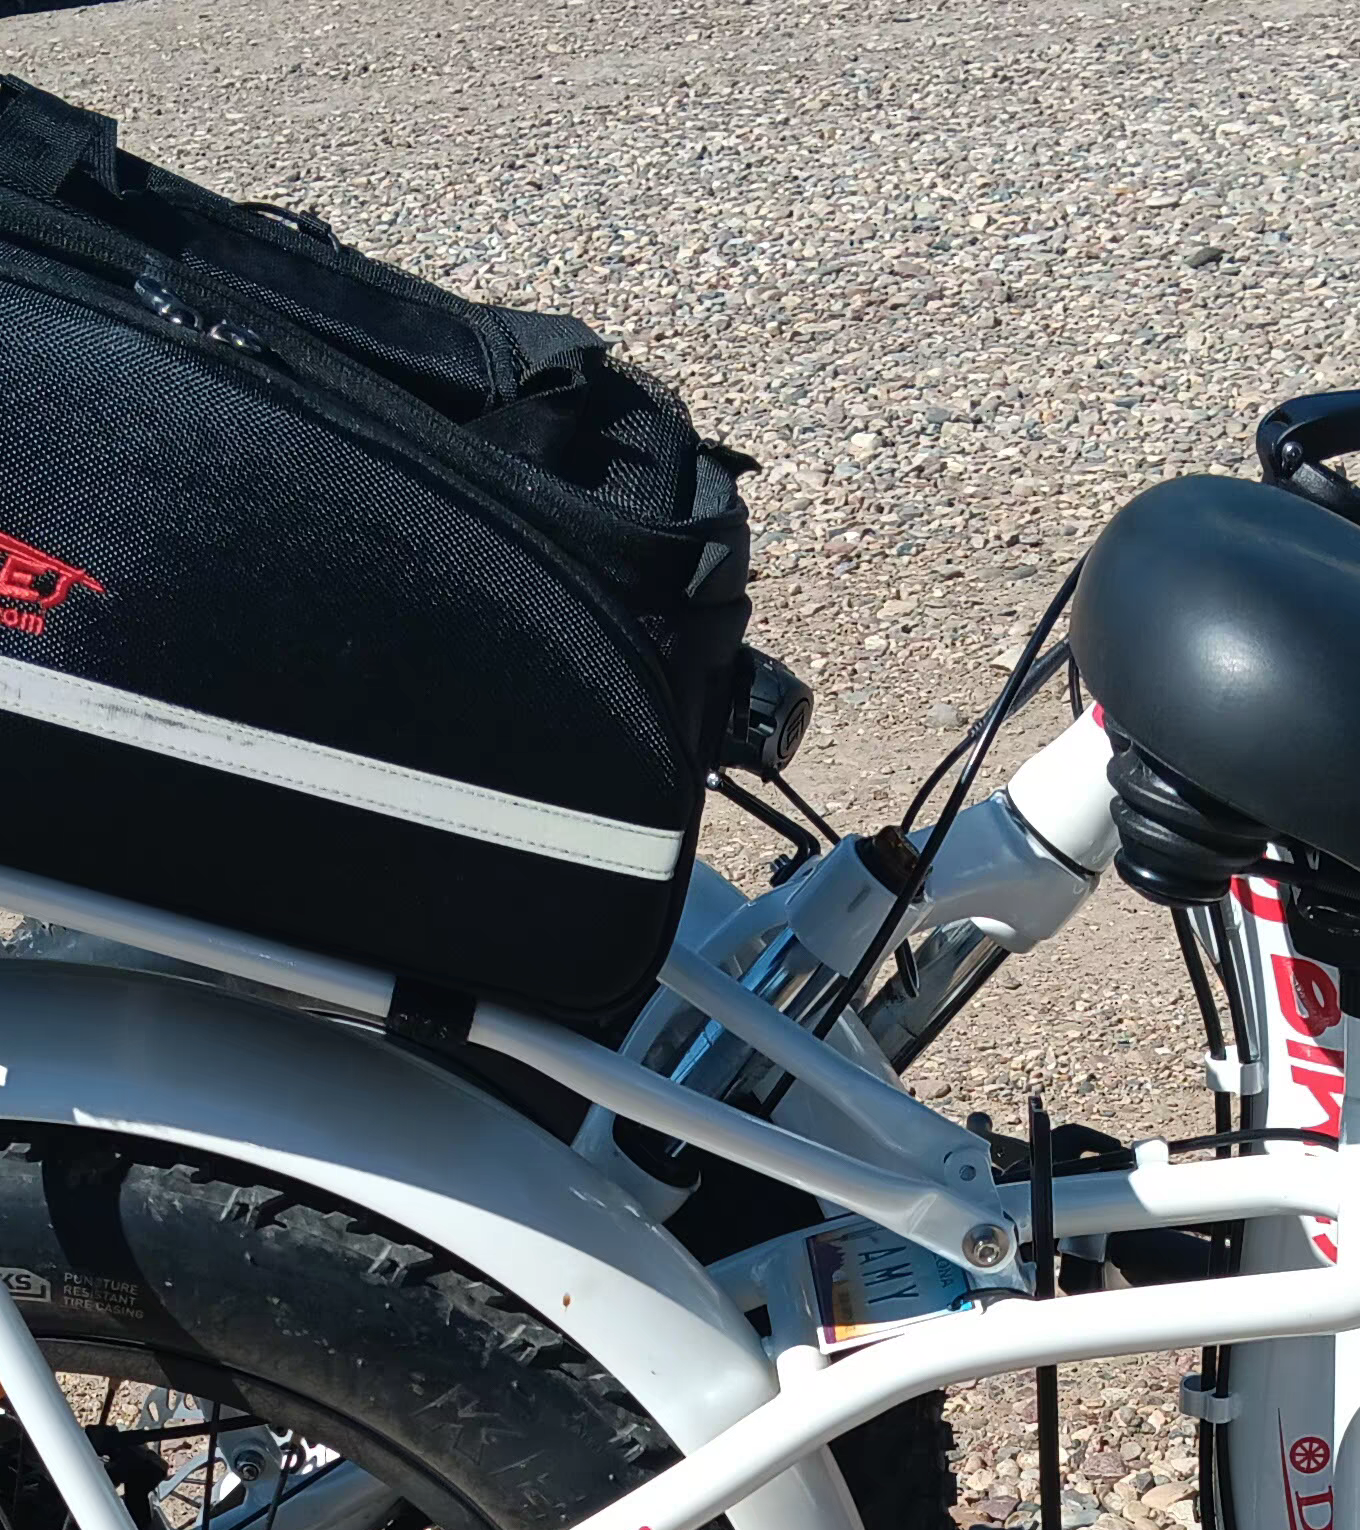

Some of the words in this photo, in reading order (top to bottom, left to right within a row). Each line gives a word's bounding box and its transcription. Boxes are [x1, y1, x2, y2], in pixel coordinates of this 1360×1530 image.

[857, 1246, 919, 1304] AMY
[63, 1284, 137, 1306] RESISTANT
[63, 1296, 93, 1309] TIRE
[95, 1302, 144, 1319] CASING
